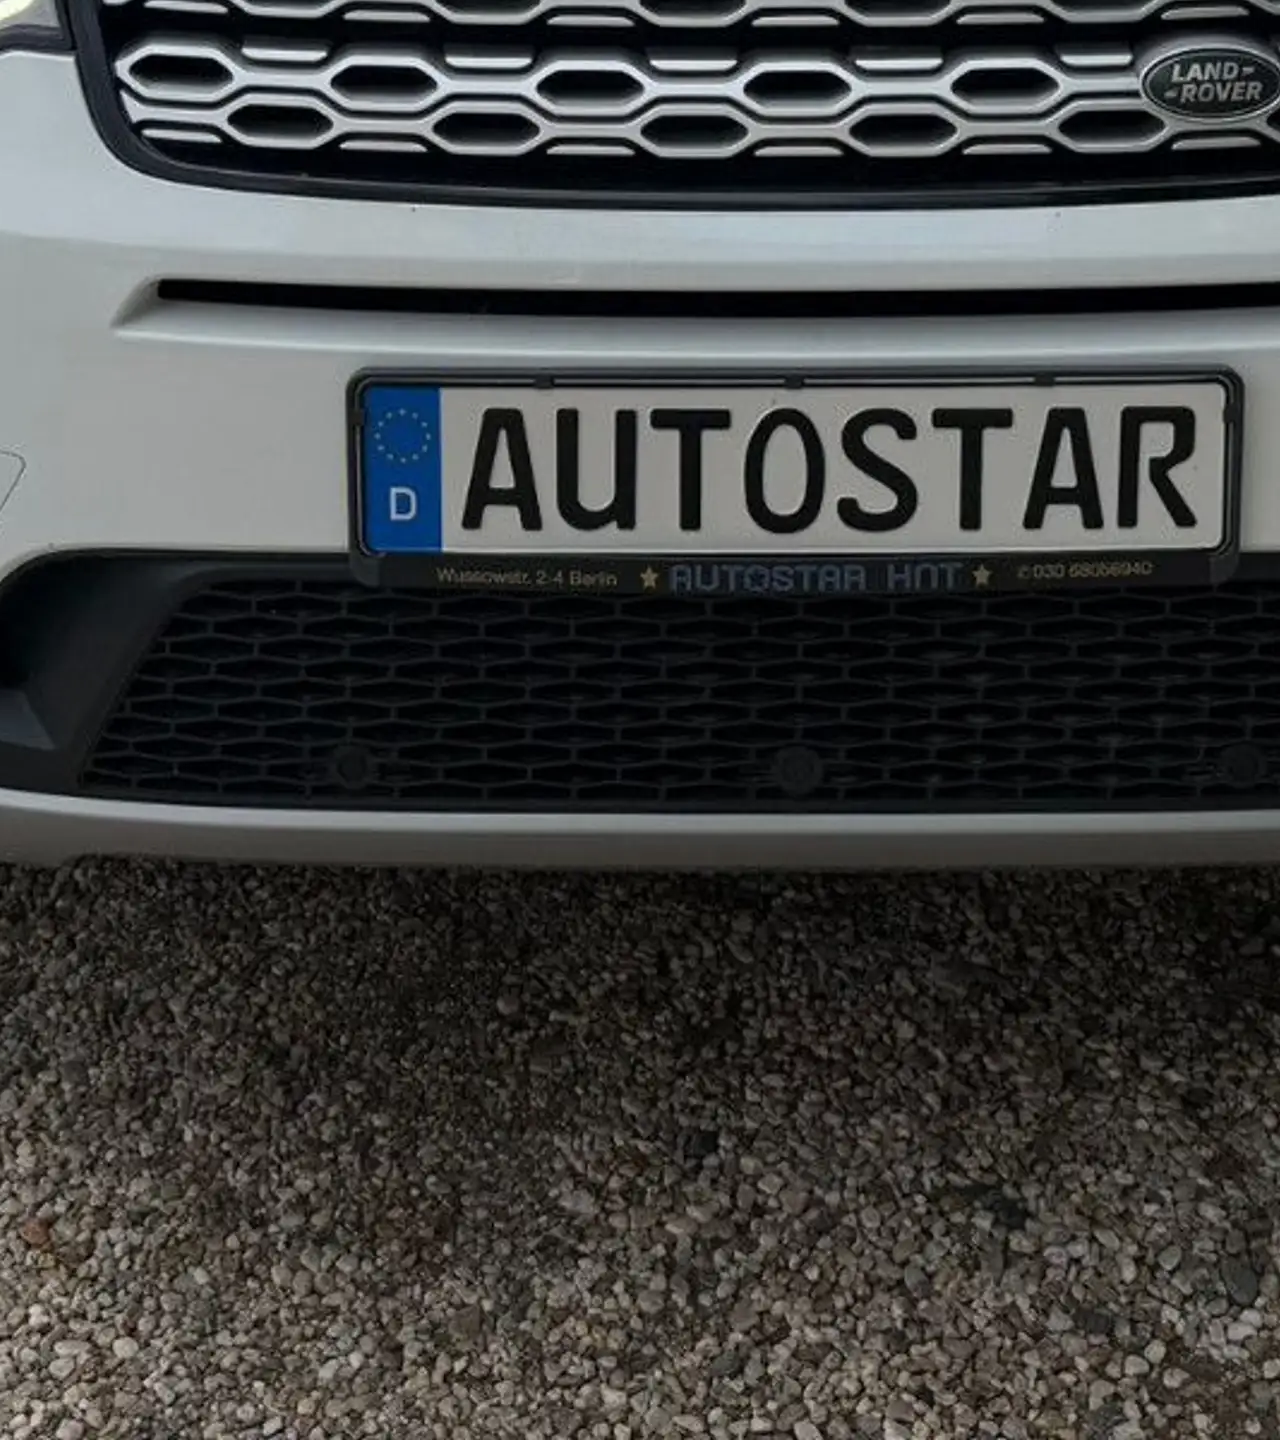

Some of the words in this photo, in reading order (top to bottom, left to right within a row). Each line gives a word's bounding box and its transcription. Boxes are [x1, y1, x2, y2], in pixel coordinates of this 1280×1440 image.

[461, 406, 1198, 534] AUTOSTAR
[389, 486, 418, 521] D
[570, 569, 618, 587] Berlin
[668, 564, 868, 592] AUTOSTAR
